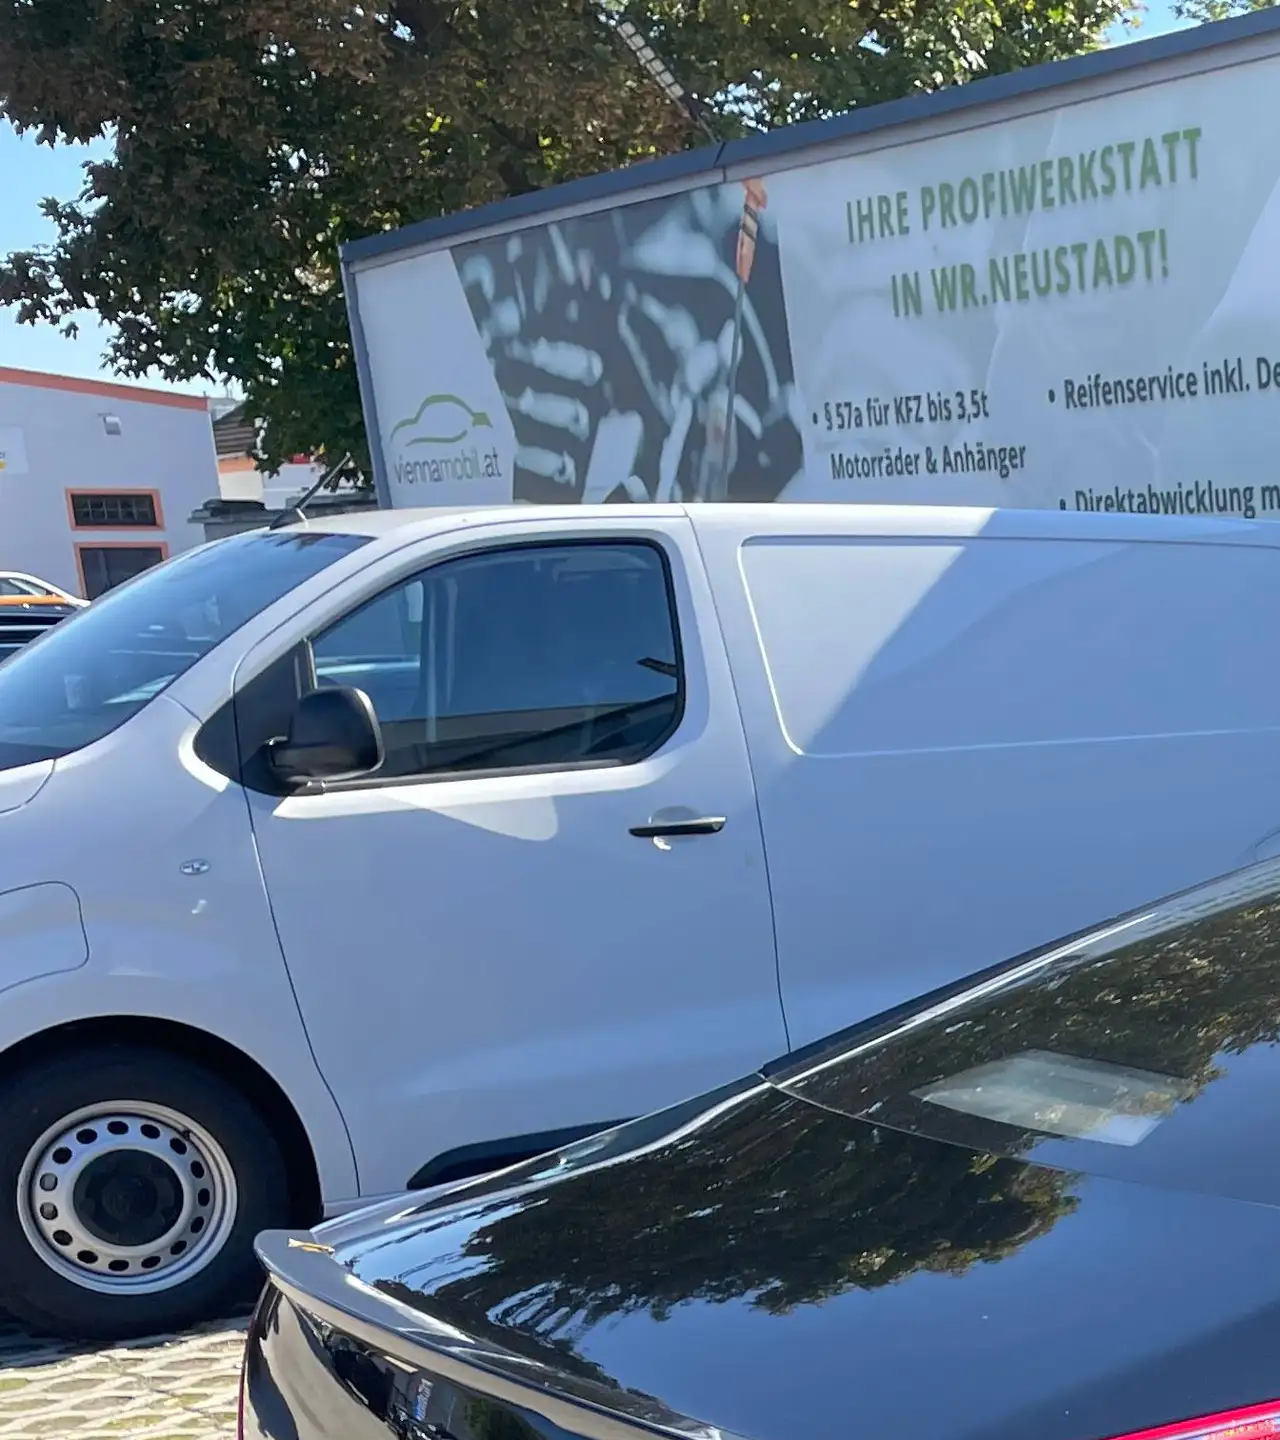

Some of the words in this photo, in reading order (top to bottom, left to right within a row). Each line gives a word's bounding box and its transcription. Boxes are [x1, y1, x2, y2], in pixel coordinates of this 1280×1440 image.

[846, 189, 910, 244] IHRE
[921, 127, 1203, 232] PROFIWERKSTATT
[890, 271, 923, 318] IN
[1064, 365, 1198, 409] Reifenservice
[1203, 357, 1250, 396] inkl.
[866, 398, 889, 426] für
[894, 395, 924, 424] KFZ
[926, 391, 951, 422] bis
[955, 389, 990, 424] 3,5t
[830, 447, 920, 480] Motorräder
[925, 446, 938, 474] &
[942, 441, 1026, 479] Anhänger
